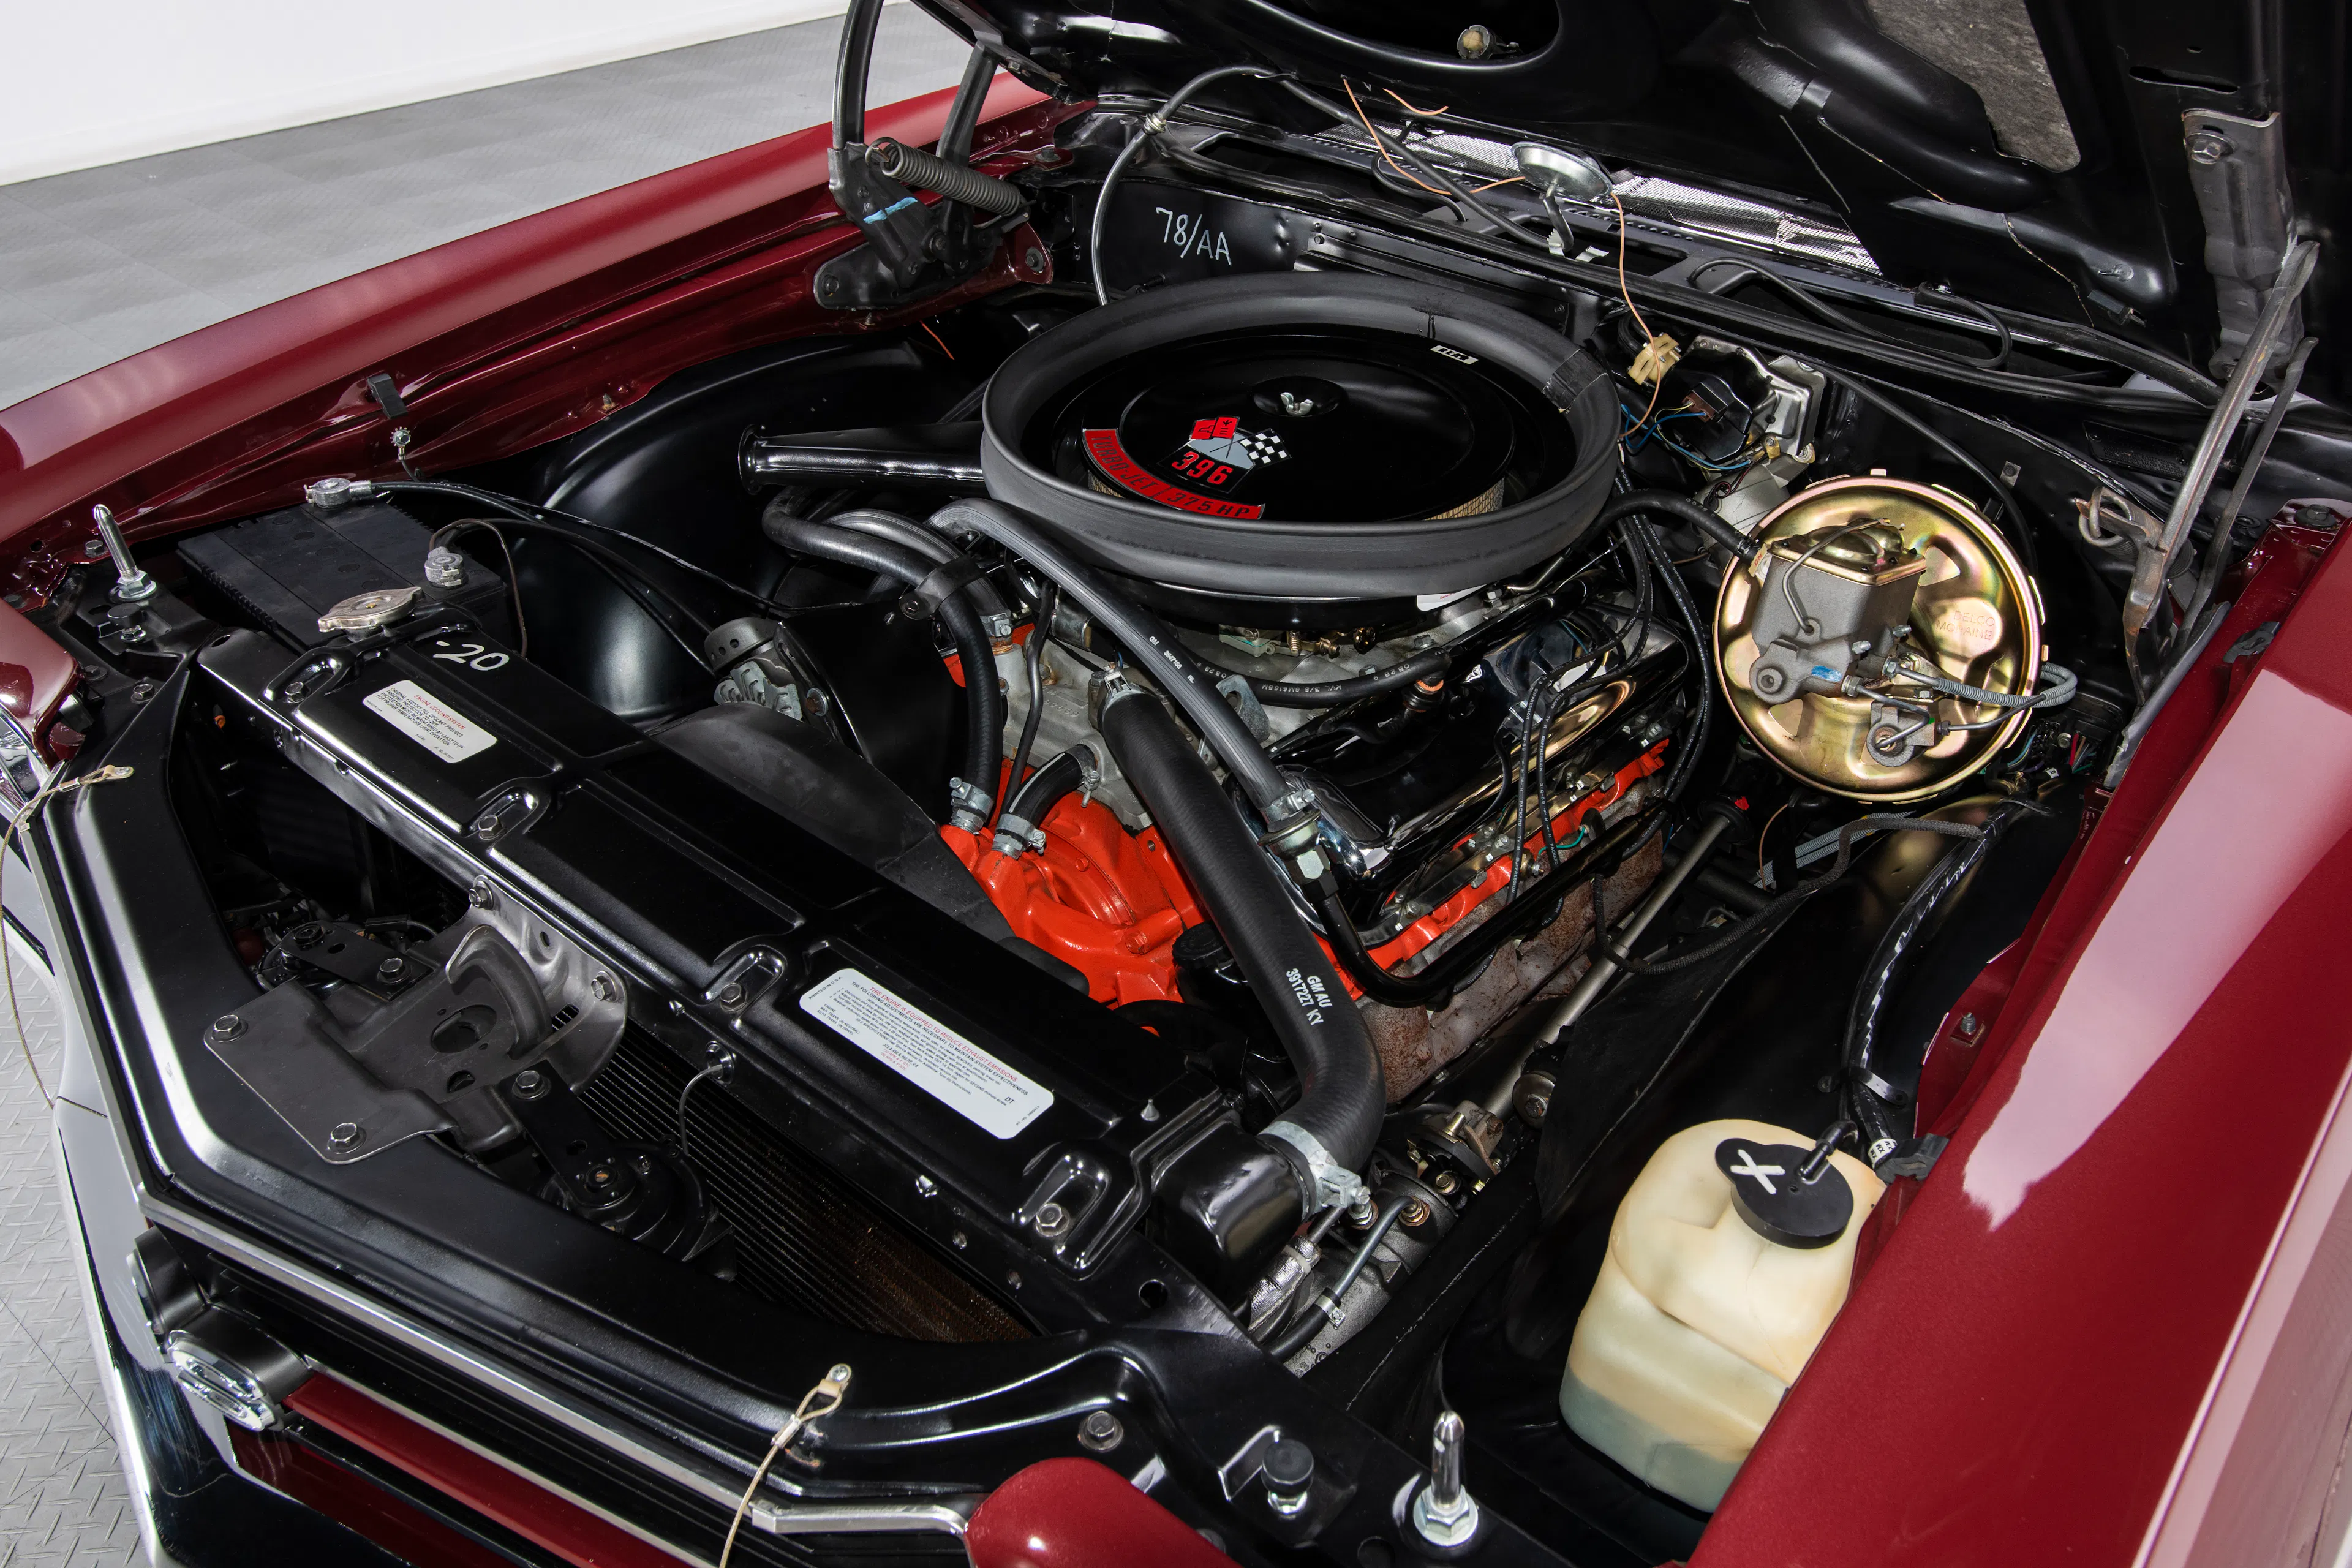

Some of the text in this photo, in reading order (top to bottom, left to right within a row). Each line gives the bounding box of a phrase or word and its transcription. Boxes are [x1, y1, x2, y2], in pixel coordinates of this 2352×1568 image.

[1155, 206, 1232, 266] 78/AA
[1438, 348, 1469, 361] REAR
[1090, 435, 1251, 517] TURBO-JET 375 HP
[1171, 451, 1234, 485] 396
[1659, 565, 1673, 585] PACKARD
[1683, 606, 1697, 635] SUPPRESSION
[1936, 620, 1992, 640] MORAINE
[1954, 610, 1995, 627] DELCO
[433, 641, 510, 671] -20
[1149, 636, 1159, 646] GM
[382, 699, 398, 709] PROPER
[395, 708, 421, 726] TEMPERATURE
[384, 690, 403, 702] FREEZING
[401, 701, 424, 716] PROTECTION
[389, 687, 407, 699] ORIGINAL
[405, 698, 423, 709] FACTORY
[428, 714, 447, 726] COOLANT
[444, 725, 463, 737] PROVIDES
[413, 695, 467, 729] ENGINE COOLING SYSTEM
[1526, 688, 1538, 720] SUPPRESSION
[1550, 693, 1564, 709] PACKARD
[380, 692, 403, 707] PROTECTION
[415, 716, 438, 731] MAINTAINED
[440, 733, 454, 742] LEAST
[1550, 843, 1559, 865] PACKARD
[1467, 965, 1487, 985] PACKARD
[807, 987, 826, 1000] PRINTED
[1286, 968, 1324, 1025] 3917227 KY
[1306, 976, 1333, 1008] GM AU
[859, 987, 884, 1003] FOLLOWING
[883, 1001, 914, 1022] ADJUSTMENTS
[921, 1027, 948, 1044] NECESSARY
[954, 1047, 975, 1061] MAINTAIN
[974, 1060, 993, 1072] SYSTEM
[992, 1071, 1029, 1095] EFFECTIVENESS
[869, 987, 883, 996] THIS
[880, 994, 902, 1008] ENGINE
[905, 1010, 933, 1028] EQUIPPED
[940, 1031, 963, 1047] REDUCE
[962, 1045, 989, 1063] EXHAUST
[987, 1061, 1018, 1082] EMISSIONS
[1004, 1096, 1015, 1104] DT
